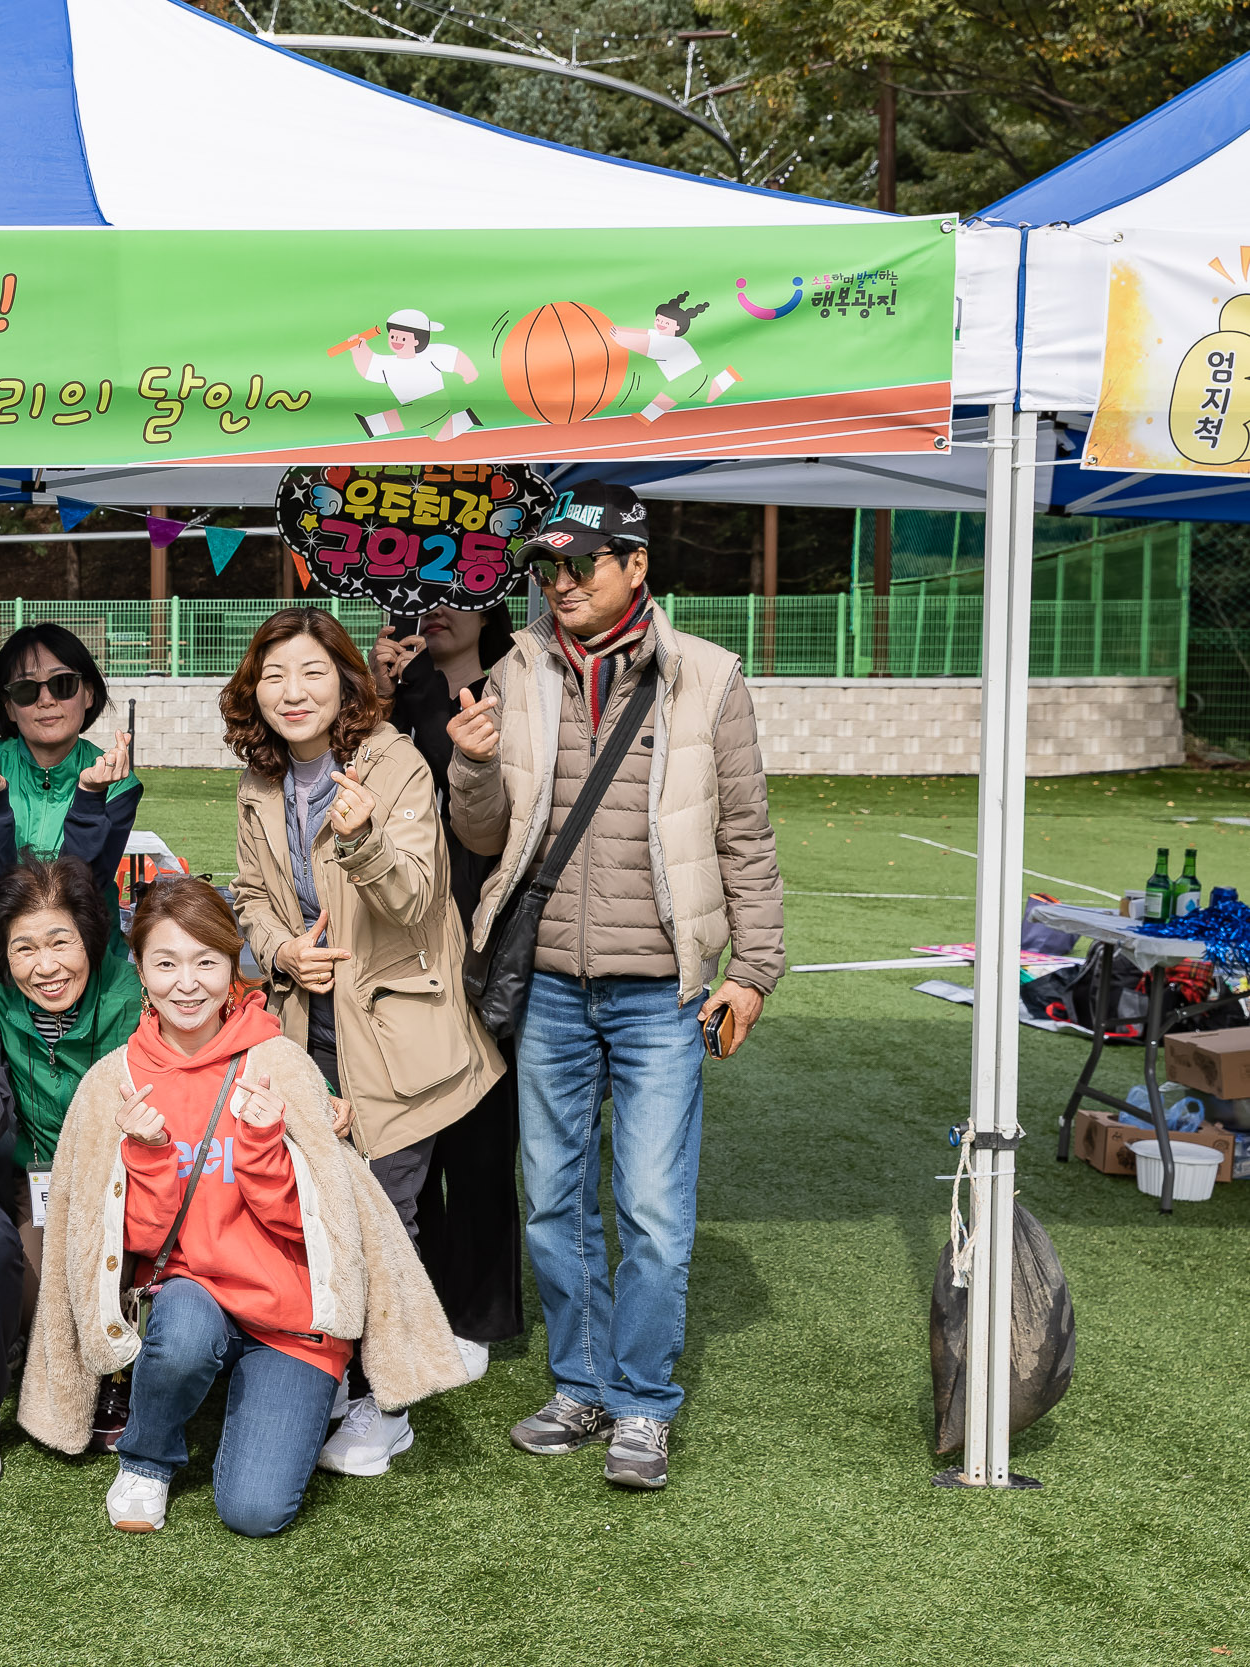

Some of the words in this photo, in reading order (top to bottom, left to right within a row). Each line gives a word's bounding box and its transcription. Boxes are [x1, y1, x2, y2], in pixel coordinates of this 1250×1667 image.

[811, 273, 854, 290] 소통하며
[856, 270, 899, 289] 발전하는
[811, 287, 898, 319] 행복광진
[139, 364, 312, 445] 달인~
[1193, 351, 1235, 449] 엄지척
[344, 479, 493, 532] 우주최강
[318, 519, 509, 593] 구의2동
